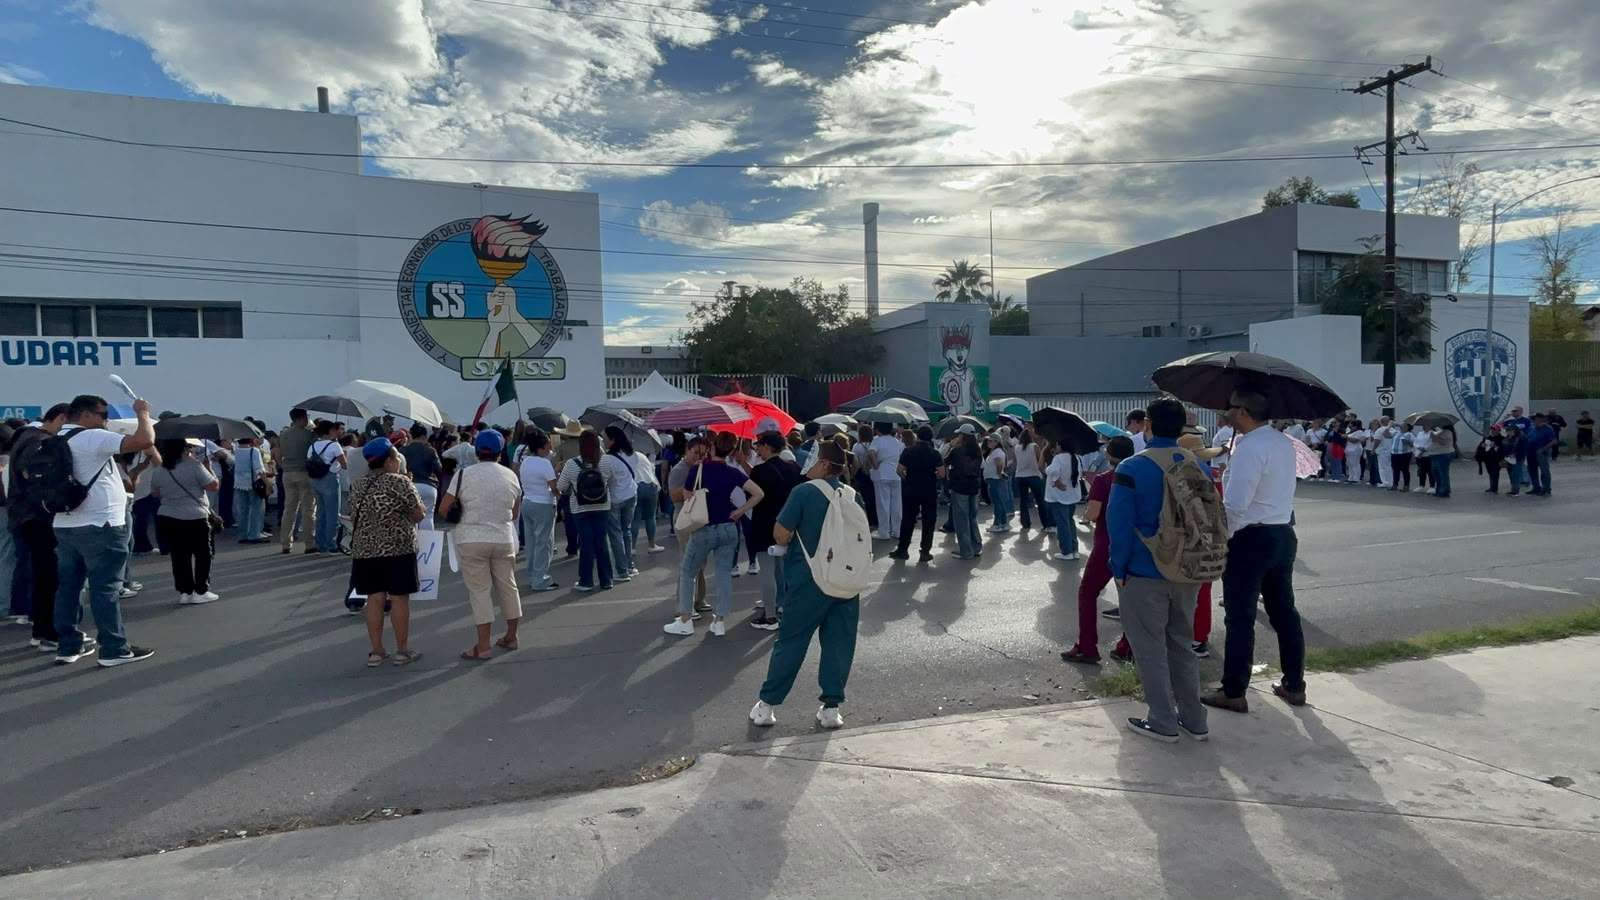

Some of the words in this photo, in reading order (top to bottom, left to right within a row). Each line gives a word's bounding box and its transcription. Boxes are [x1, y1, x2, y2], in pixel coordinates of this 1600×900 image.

[440, 226, 456, 238] DE
[454, 221, 472, 233] LOS
[430, 281, 466, 319] SS
[540, 251, 566, 350] TRABAJADORES
[401, 286, 436, 352] BIENESTAR
[1, 340, 157, 366] UDARTE
[437, 352, 447, 363] Y
[0, 407, 25, 420] AR
